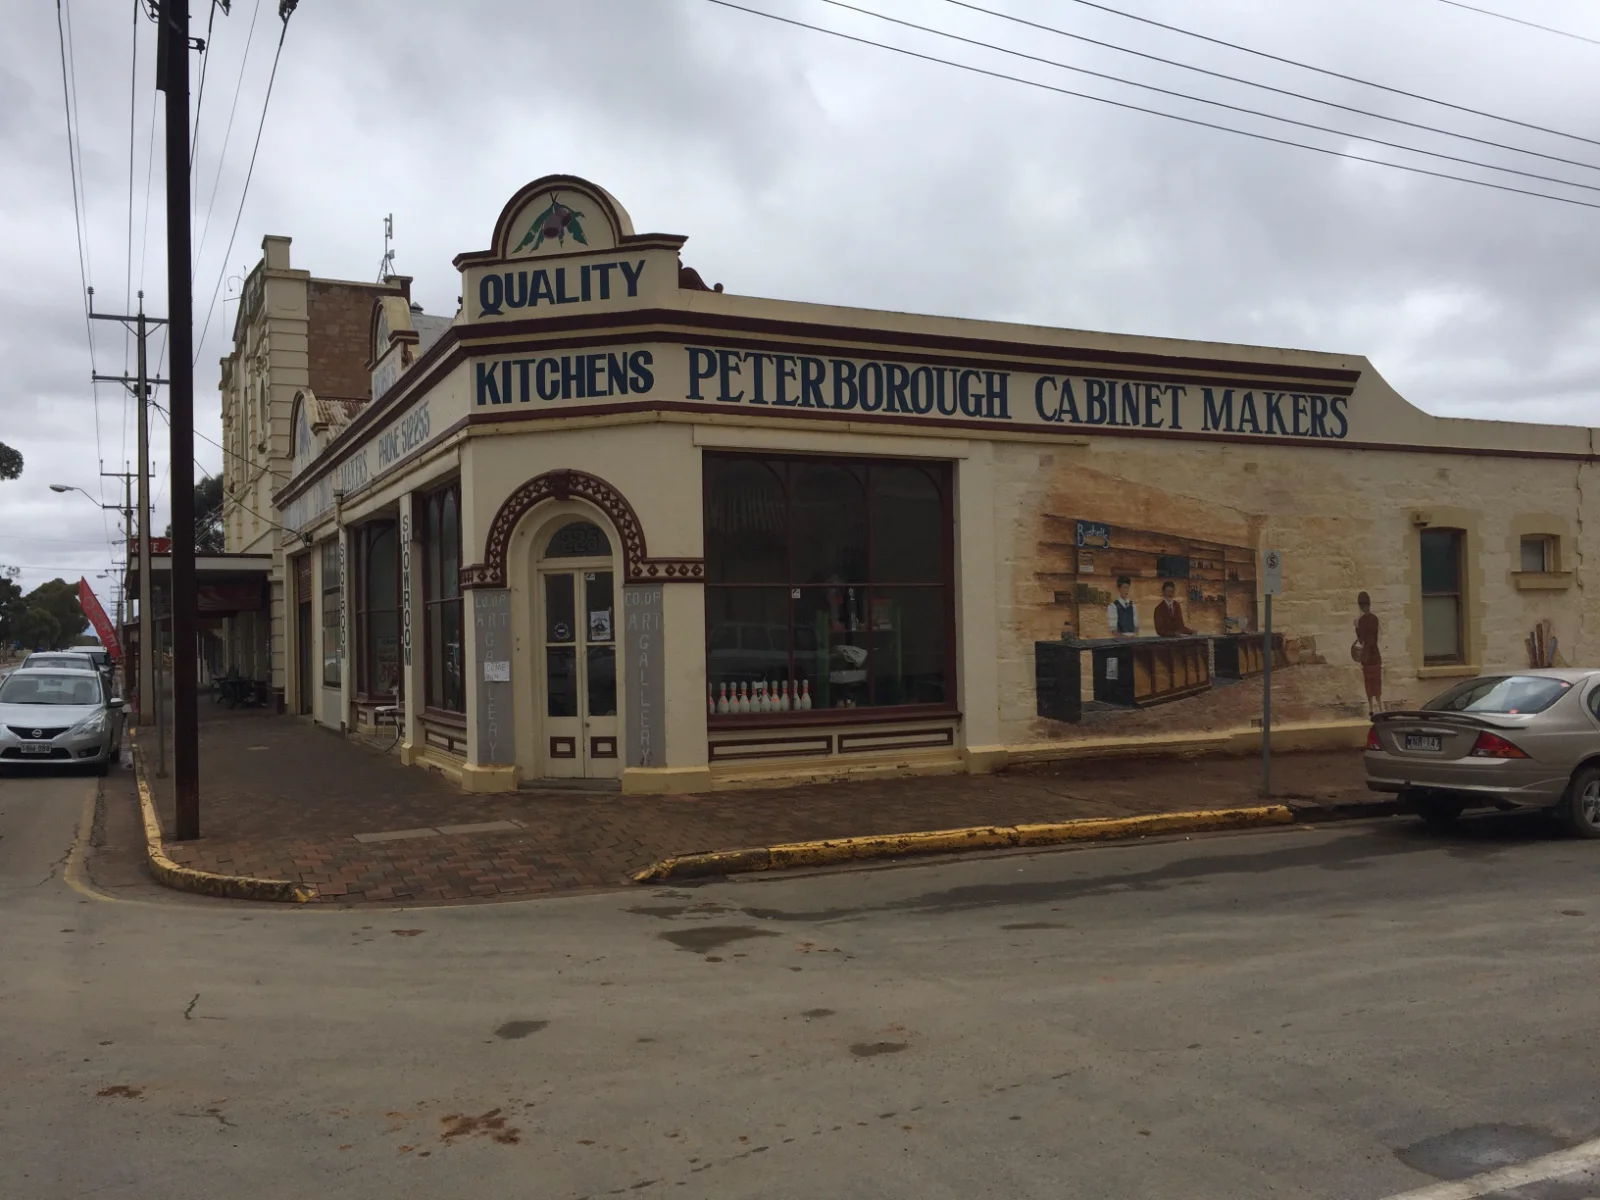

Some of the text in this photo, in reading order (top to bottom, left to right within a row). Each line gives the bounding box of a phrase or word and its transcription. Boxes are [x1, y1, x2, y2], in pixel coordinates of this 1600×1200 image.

[478, 260, 646, 318] QUALITY
[476, 350, 654, 405] KITCHENS
[684, 347, 1349, 439] PETERBOROUGH CABINET MAKERS
[379, 425, 399, 469] PHONE
[402, 515, 412, 666] SHOWROOM
[476, 613, 508, 627] ART
[628, 613, 661, 630] ART
[485, 632, 498, 759] GALERY
[487, 663, 506, 672] COME
[639, 636, 651, 765] GALLERY
